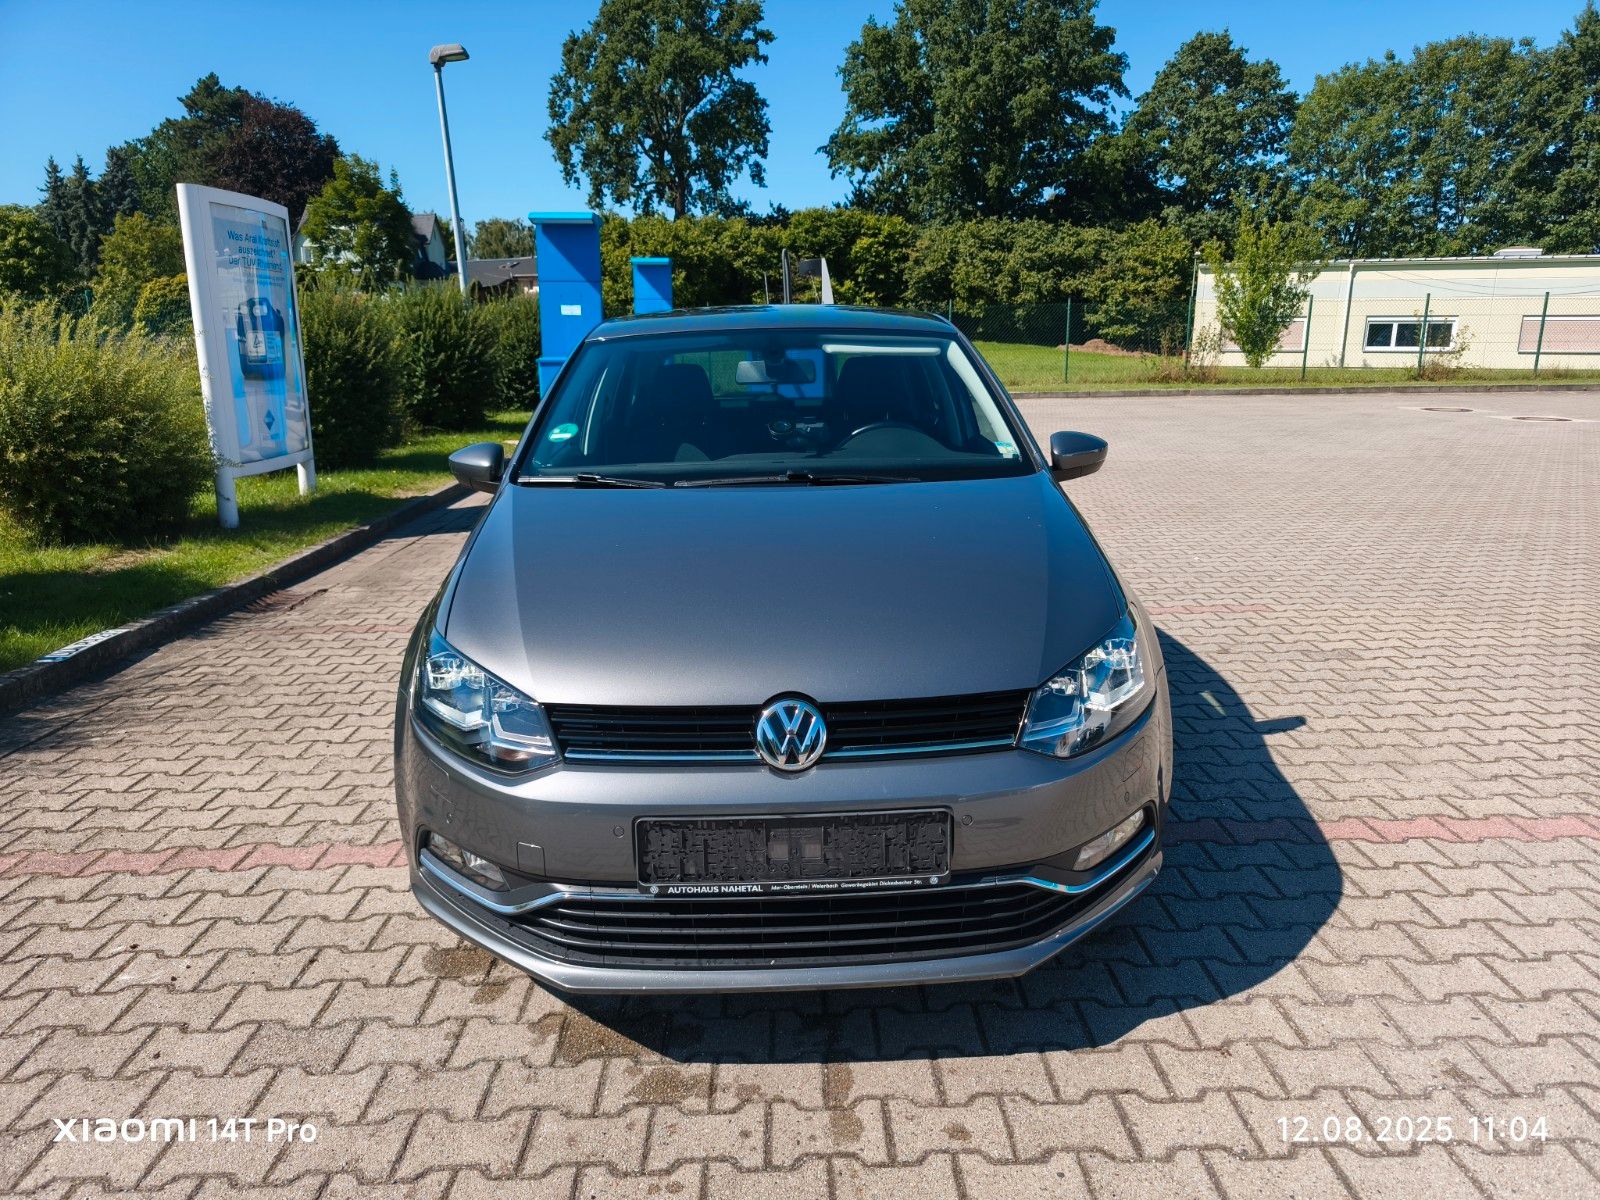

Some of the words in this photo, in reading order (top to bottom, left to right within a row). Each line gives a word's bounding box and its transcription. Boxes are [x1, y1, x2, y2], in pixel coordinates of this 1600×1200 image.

[227, 230, 243, 242] Was
[667, 885, 719, 894] AUTOHAUS
[721, 884, 763, 893] NAHETAL
